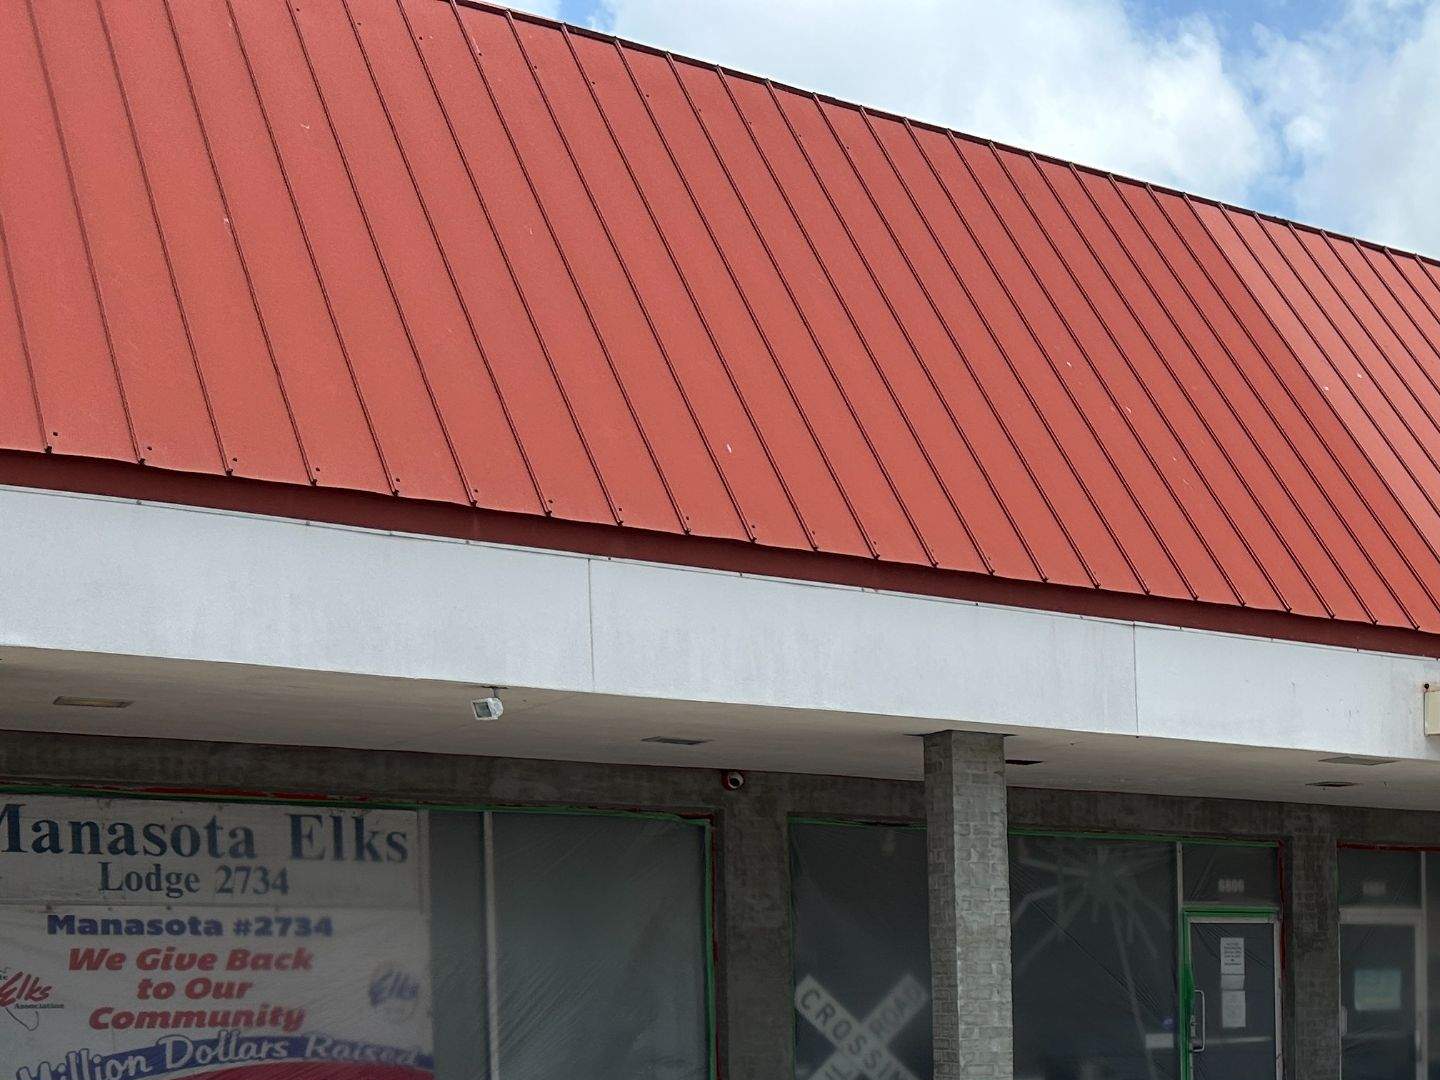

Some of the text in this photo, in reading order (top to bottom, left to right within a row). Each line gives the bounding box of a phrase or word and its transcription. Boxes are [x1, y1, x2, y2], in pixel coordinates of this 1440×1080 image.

[288, 813, 410, 864] Elks
[98, 861, 289, 898] Lodge 2734
[47, 914, 334, 937] Manasota #2734
[68, 947, 315, 971] We Give Back
[137, 977, 254, 1001] to Our
[88, 1004, 307, 1032] Community
[157, 1029, 290, 1068] Dollars
